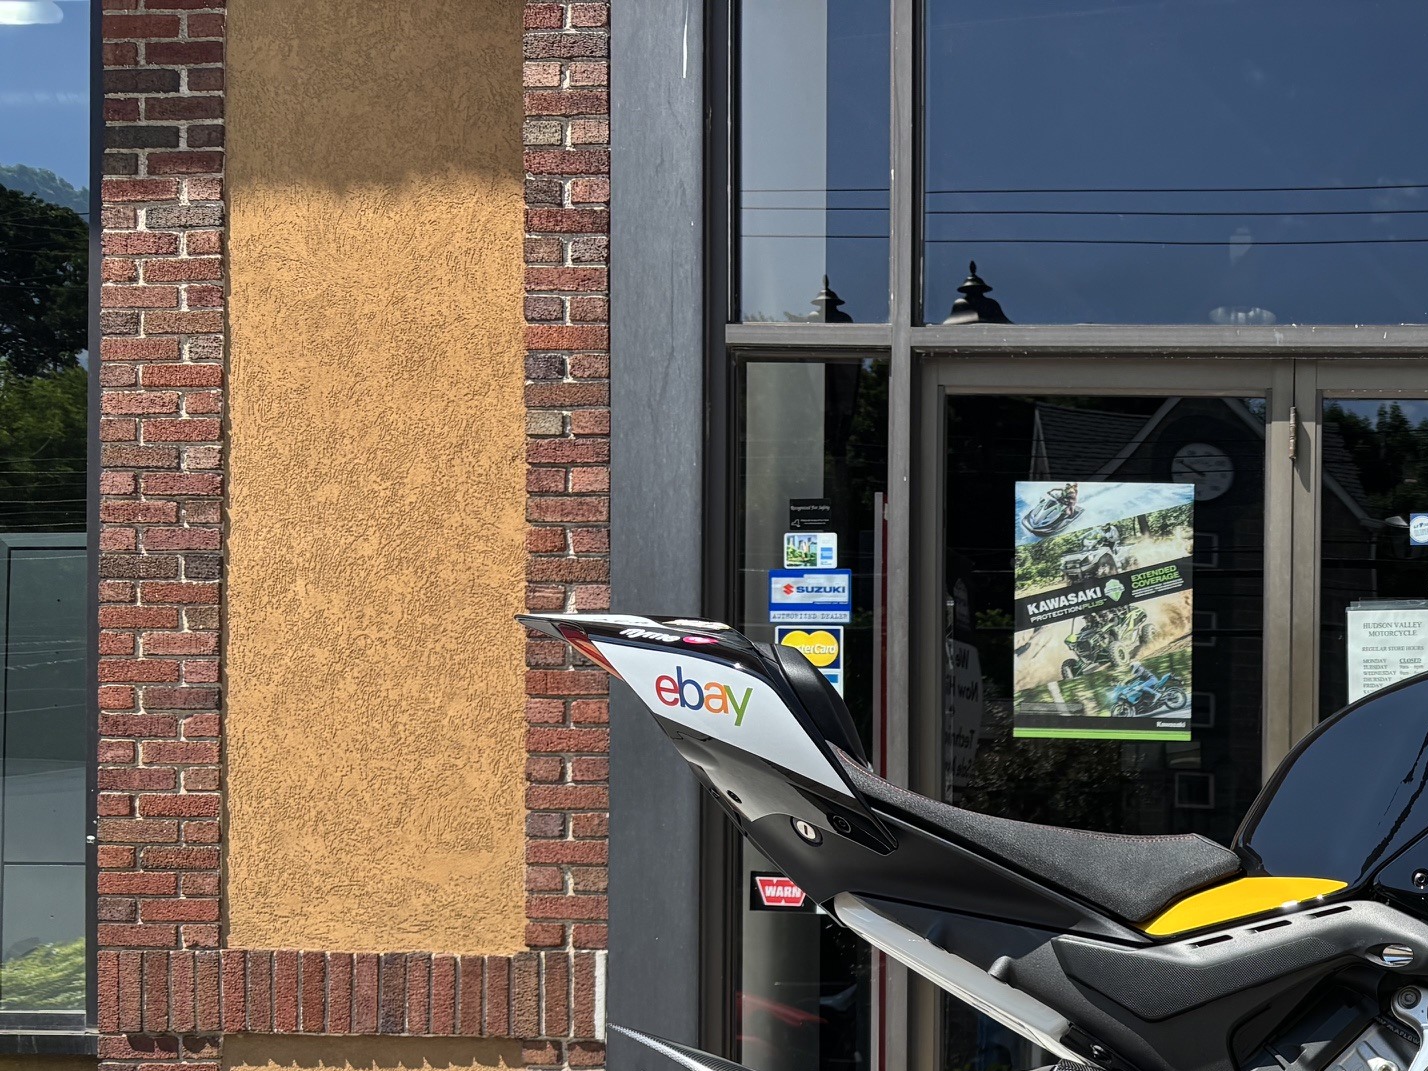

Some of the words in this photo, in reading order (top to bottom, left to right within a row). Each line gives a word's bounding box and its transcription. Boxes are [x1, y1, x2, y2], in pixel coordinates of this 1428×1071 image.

[1130, 565, 1177, 582] EXTENDED
[1131, 572, 1180, 589] COVERAGE
[796, 586, 846, 594] SUZUKI
[1027, 586, 1102, 616] KAWASAKI
[655, 666, 753, 727] ebay
[764, 885, 802, 897] WARN
